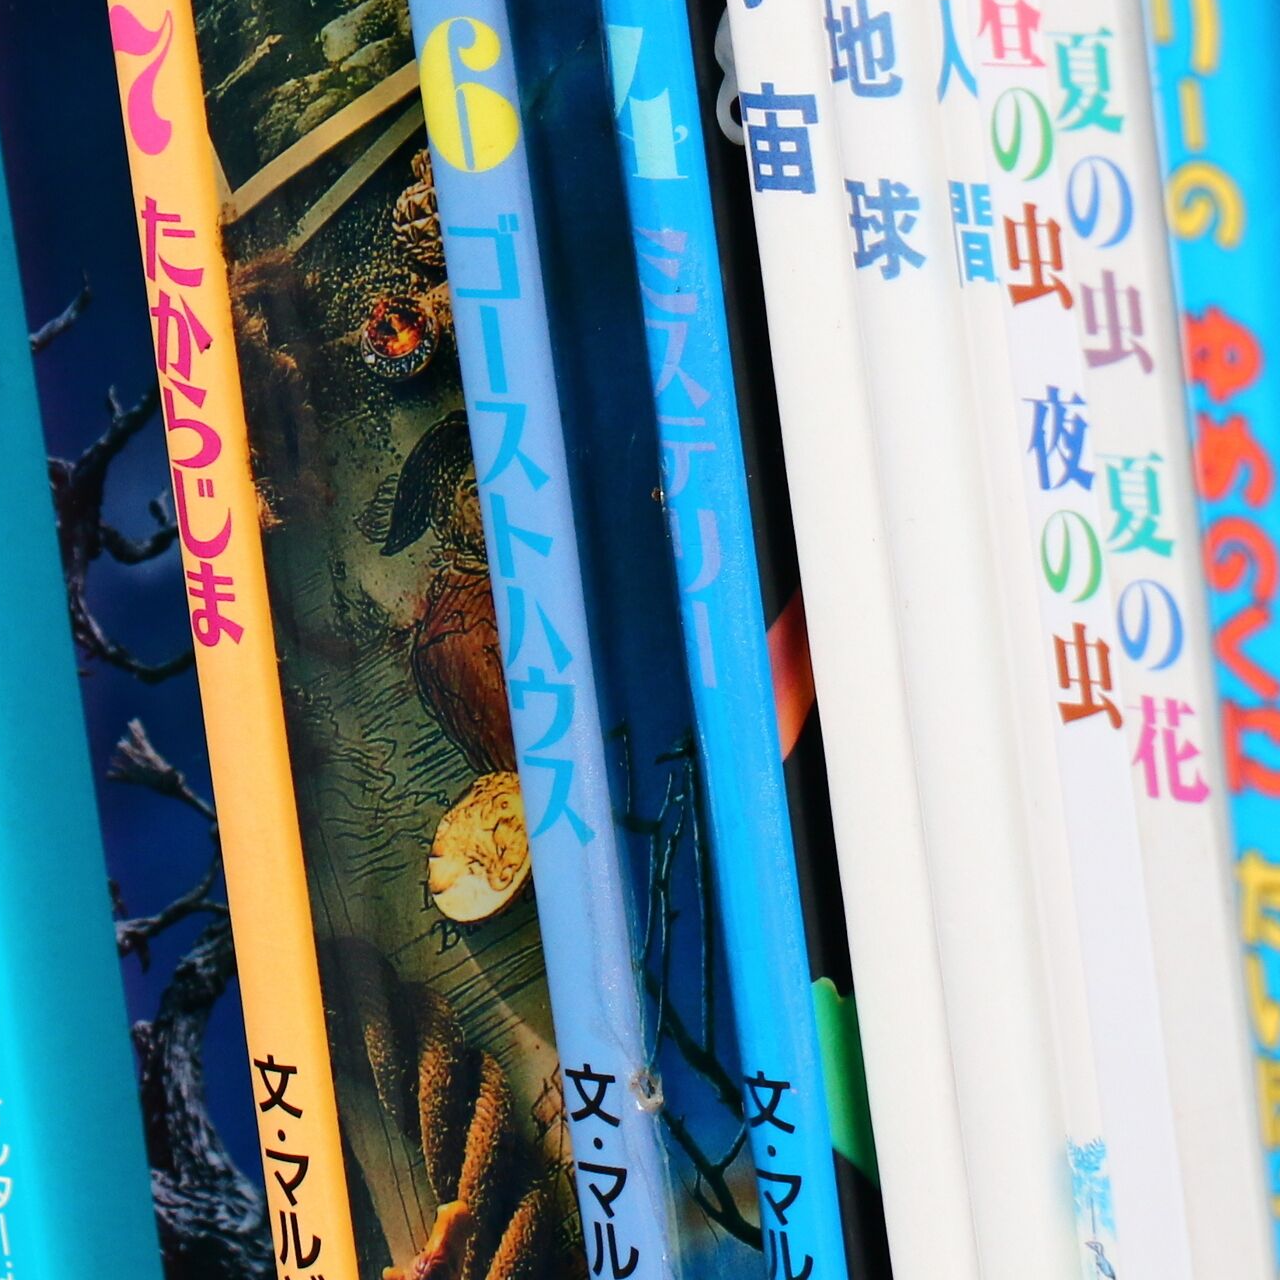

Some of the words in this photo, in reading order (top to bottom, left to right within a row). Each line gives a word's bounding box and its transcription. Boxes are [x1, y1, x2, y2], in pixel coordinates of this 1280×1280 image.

[108, 3, 173, 157] 7
[419, 16, 520, 174] 6
[606, 25, 689, 180] 4
[1042, 27, 1155, 375] 夏の虫
[140, 195, 244, 648] たからじま
[447, 213, 595, 848] ゴーストハウス
[631, 227, 717, 689] ミステリー
[1021, 385, 1124, 731] 夜の虫
[1093, 451, 1211, 804] 夏の花
[253, 1054, 327, 1280] 文・マル
